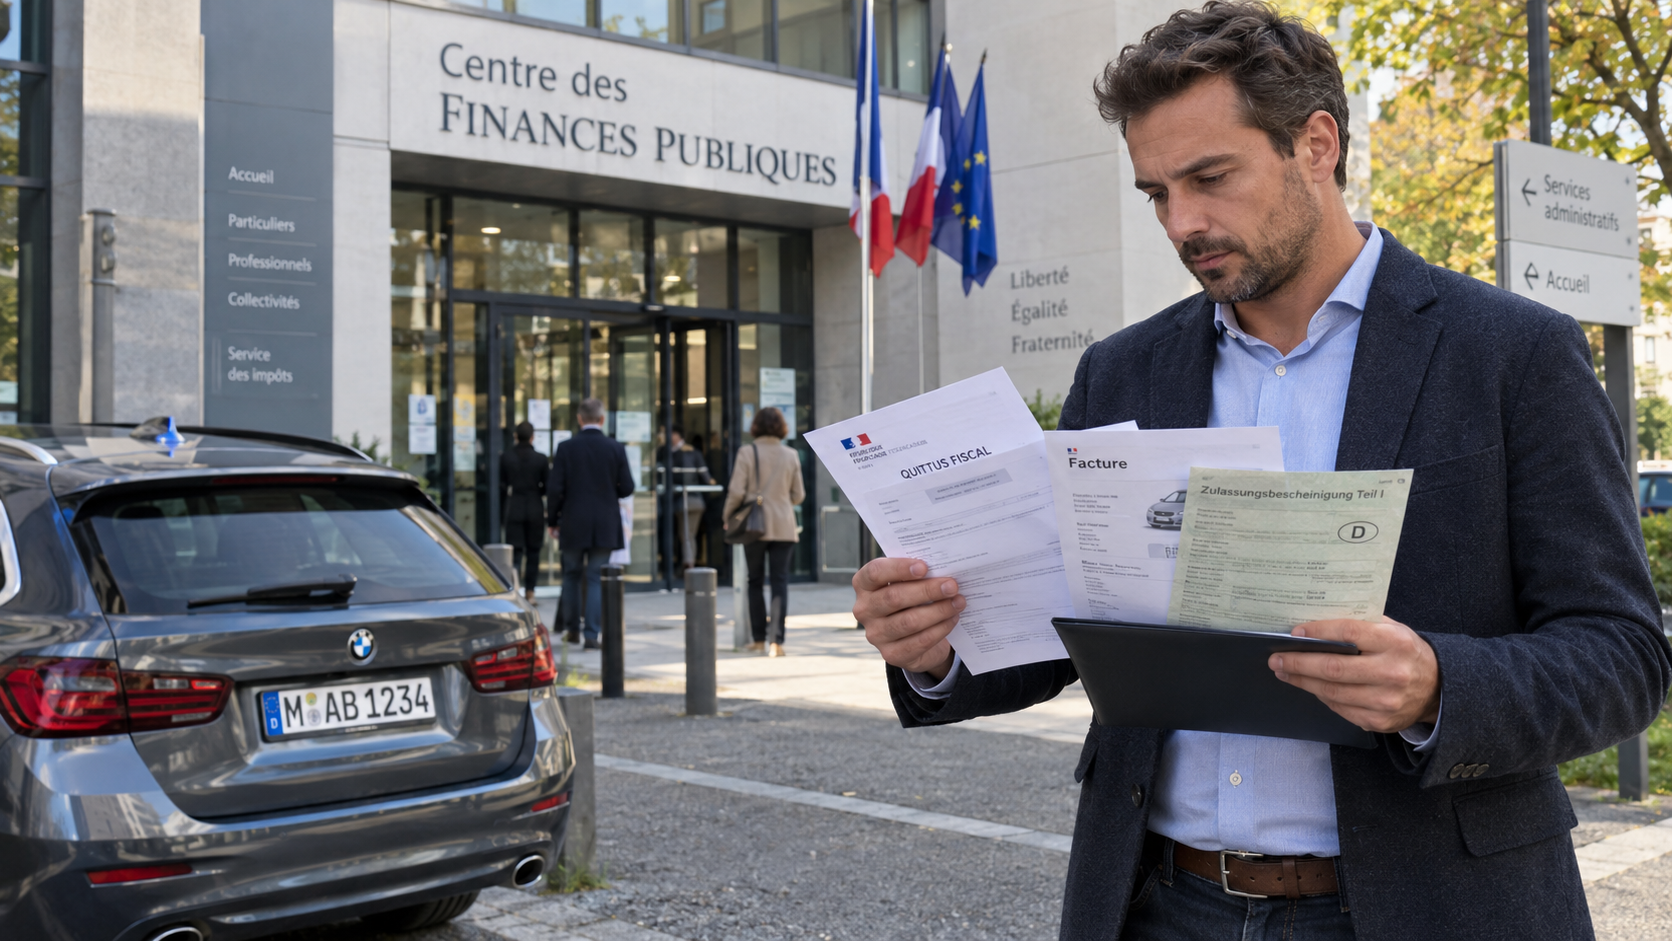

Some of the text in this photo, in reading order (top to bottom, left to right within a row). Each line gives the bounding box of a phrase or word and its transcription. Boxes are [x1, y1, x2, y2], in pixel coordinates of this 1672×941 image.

[440, 42, 628, 102] Centre des
[439, 92, 837, 186] FINANCES PUBLIQUES
[228, 166, 274, 184] Accueil
[1544, 174, 1591, 201] Services
[228, 213, 295, 232] Particuliers
[1544, 202, 1620, 232] administratifs
[228, 253, 312, 272] Professionnels
[1010, 264, 1069, 290] Liberté
[1546, 270, 1590, 294] Accueil
[228, 292, 300, 310] Collectivités
[1011, 298, 1068, 326] Égalité
[1012, 328, 1094, 354] Fraternité
[228, 346, 271, 362] Service
[228, 367, 294, 385] des impôts
[900, 458, 950, 480] QUITTUS
[950, 446, 992, 466] FISCAL
[1068, 457, 1128, 470] Facture
[1200, 485, 1353, 501] Zulassungsbescheinigung
[1357, 489, 1378, 499] Teil
[1351, 525, 1366, 539] D
[284, 695, 304, 728] M
[270, 718, 279, 730] D
